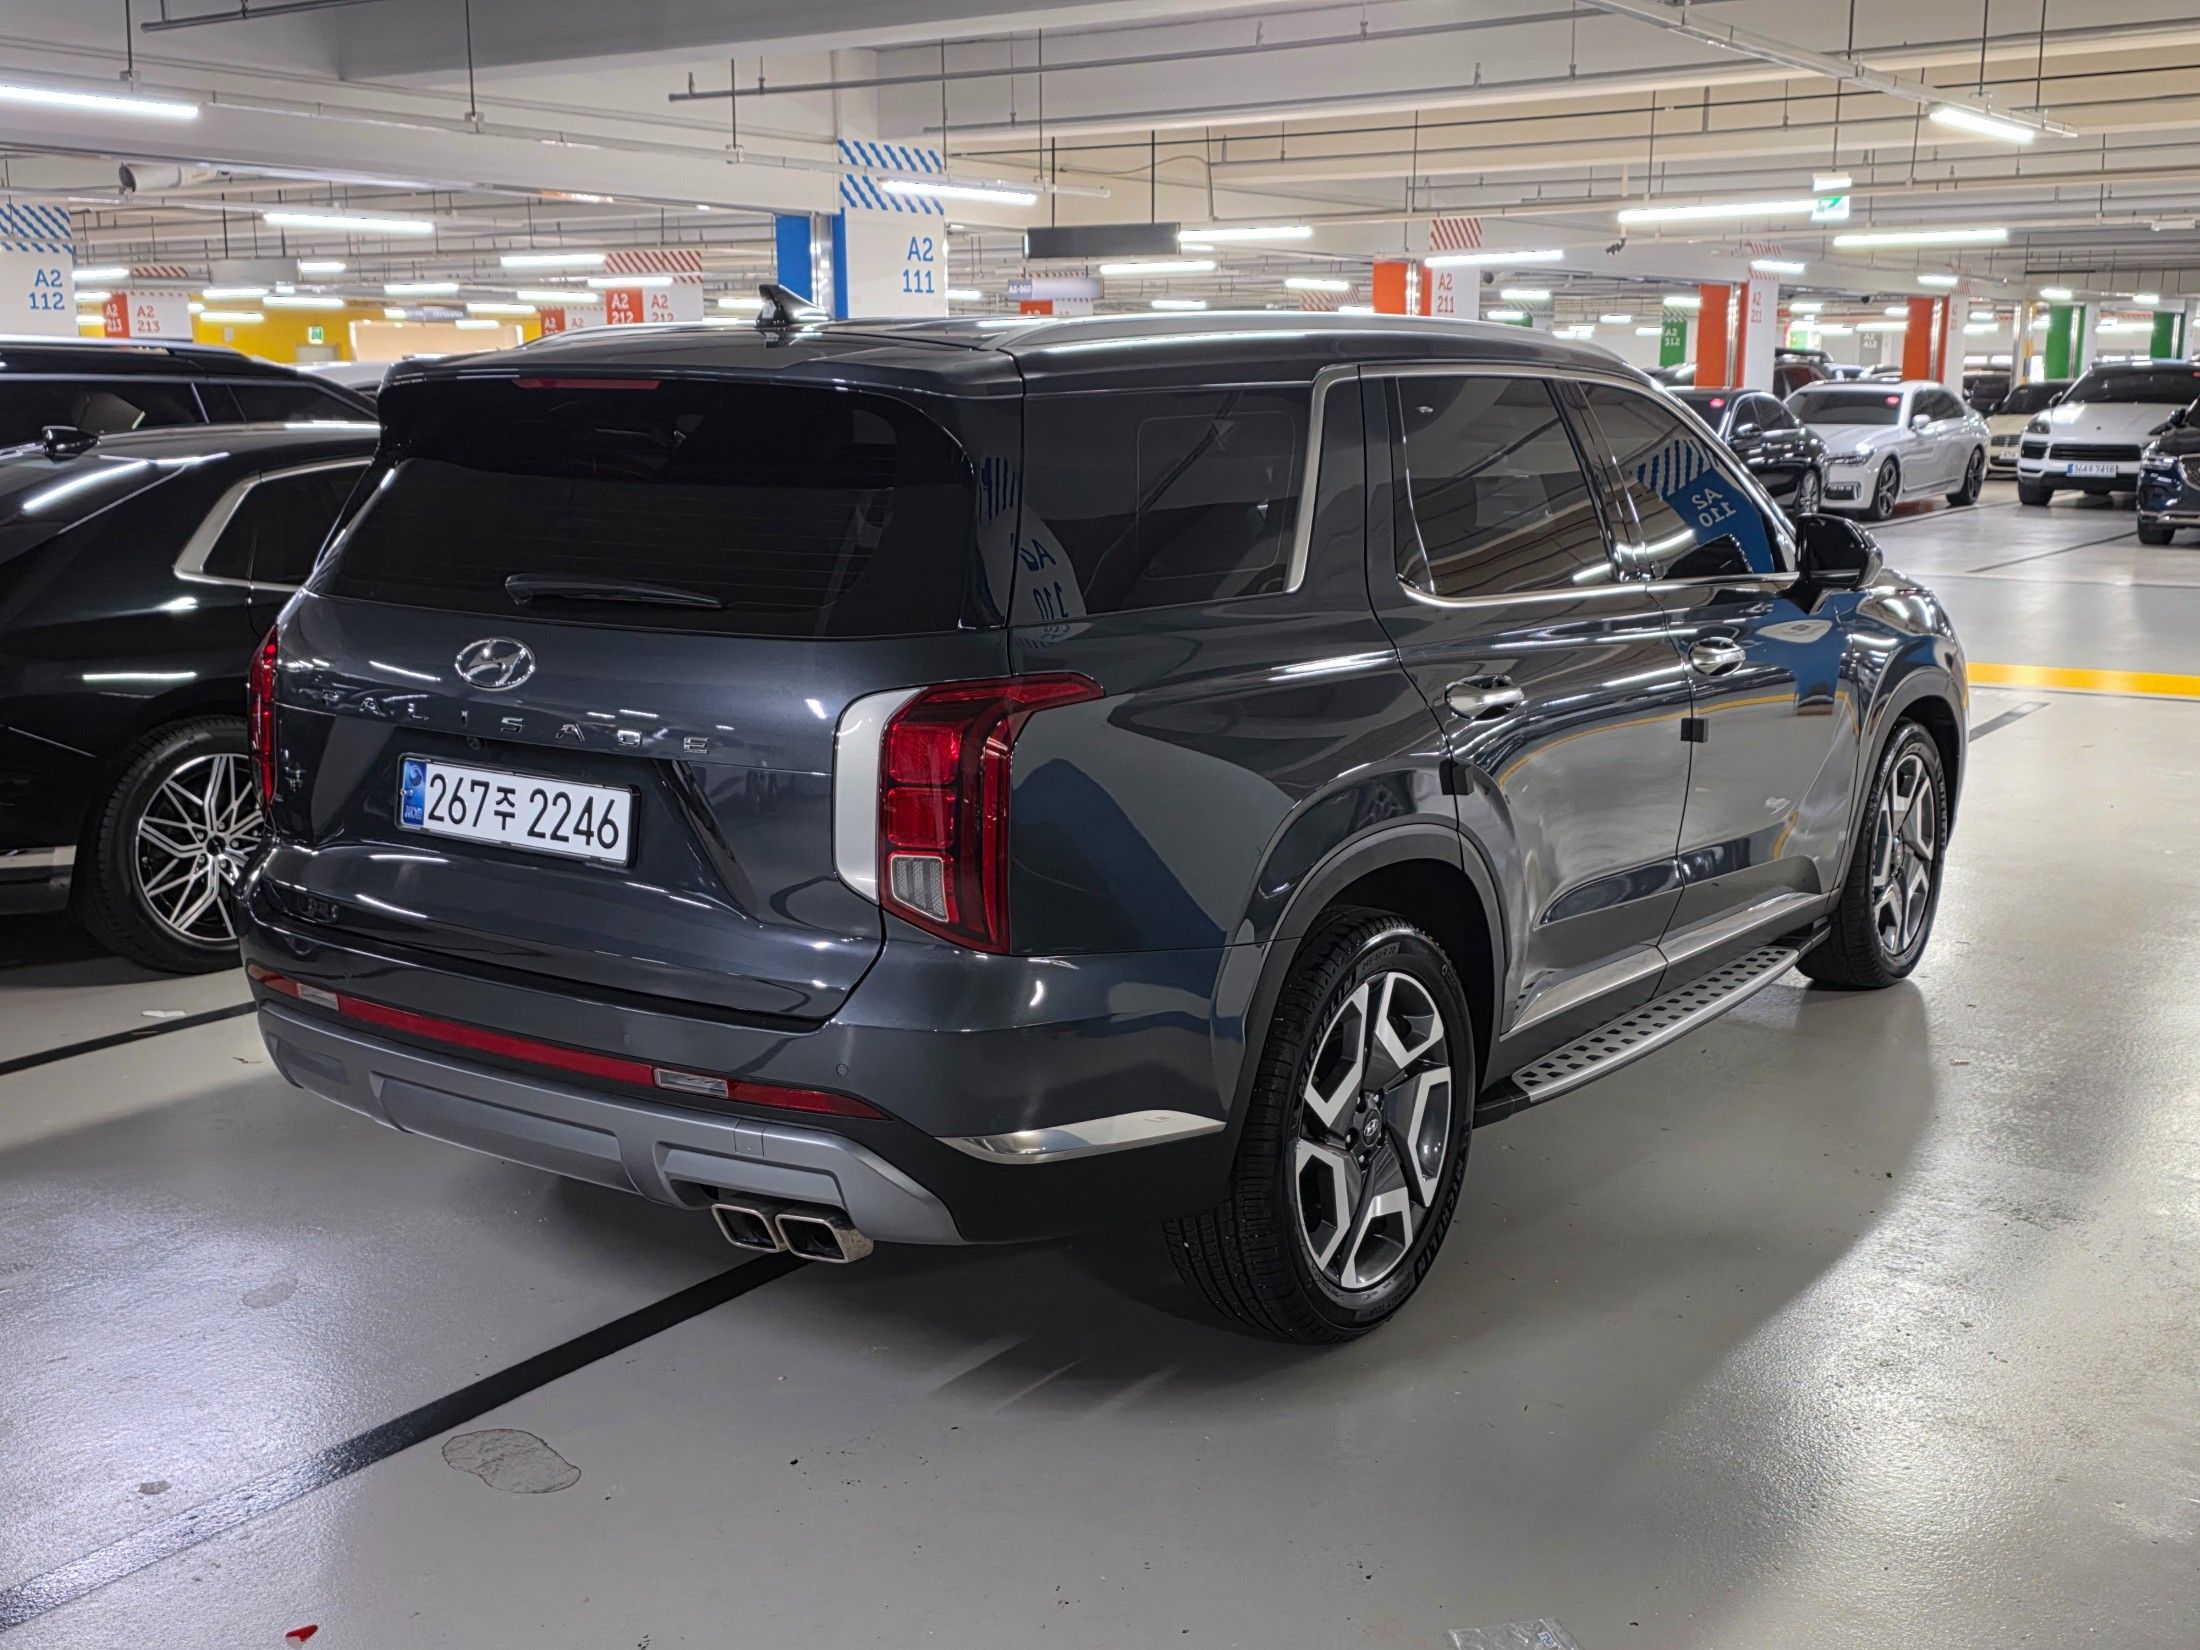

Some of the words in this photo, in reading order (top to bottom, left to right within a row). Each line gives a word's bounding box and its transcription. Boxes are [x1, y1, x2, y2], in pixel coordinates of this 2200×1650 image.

[907, 236, 934, 262] A2
[34, 269, 63, 288] A2
[902, 269, 935, 293] 111
[1439, 272, 1453, 290] A2
[29, 292, 65, 310] 112
[611, 294, 629, 309] A2
[651, 295, 668, 309] A2
[1437, 296, 1454, 313] 211
[106, 304, 118, 316] A2
[137, 305, 155, 318] A2
[611, 311, 634, 324] 212
[137, 320, 160, 333] 213
[544, 317, 557, 329] A2
[572, 317, 584, 328] A2
[1665, 328, 1678, 337] A2
[322, 689, 710, 754] PALISADE
[428, 773, 516, 831] 267주
[527, 788, 619, 849] 2246
